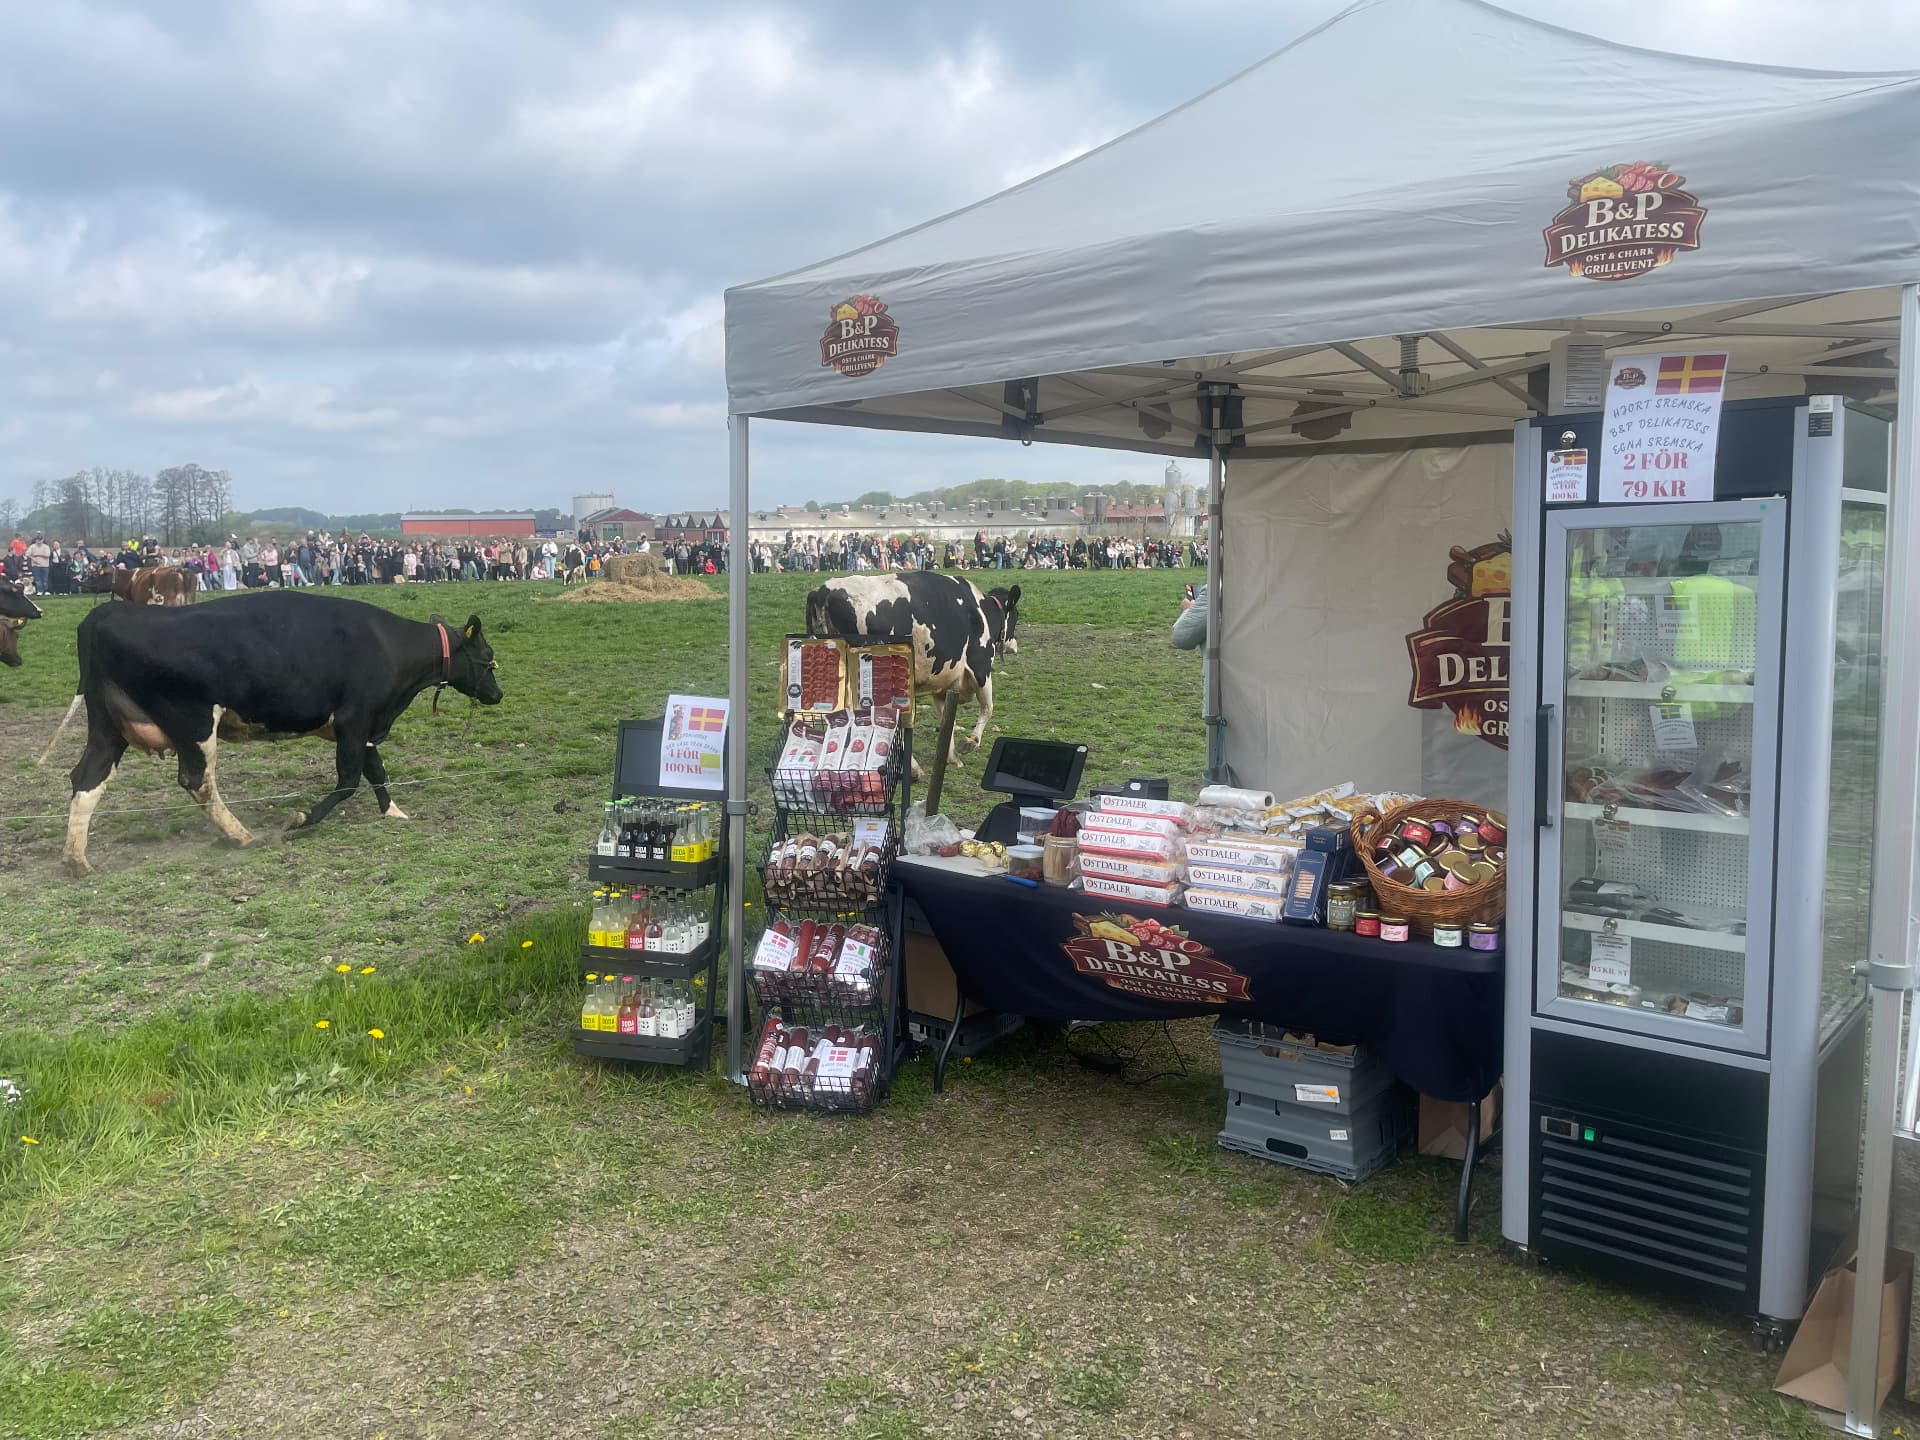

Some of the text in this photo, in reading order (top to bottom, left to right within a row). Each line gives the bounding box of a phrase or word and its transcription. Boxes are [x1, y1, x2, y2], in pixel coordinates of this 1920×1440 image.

[1585, 192, 1663, 229] B&P
[1560, 221, 1685, 254] DELIKATESS
[1585, 247, 1655, 263] OST & CHARK
[1584, 258, 1655, 275] GRILLEVENT
[839, 315, 878, 340] B&P
[829, 336, 890, 357] DELIKATESS
[1655, 398, 1713, 415] SREMSKA
[1609, 416, 1711, 438] B&P DELIKATESS
[1612, 436, 1704, 455] EGNA SREMSKA
[1623, 449, 1689, 471] 2 FÖR
[1622, 479, 1687, 498] 79 KR
[665, 762, 685, 773] 100
[1103, 796, 1147, 809] OSTDALER
[1088, 813, 1132, 827] OSTDALER
[1081, 832, 1126, 845] OSTDALER
[1190, 846, 1241, 860] OSTDALER
[1083, 857, 1129, 872] OSTDALER
[1192, 869, 1242, 884] OSTDALER
[1085, 879, 1131, 894] OSTDALER
[1189, 895, 1239, 910] OSTDALER
[1103, 939, 1191, 972] B&P
[1085, 956, 1228, 994] DELIKATESS
